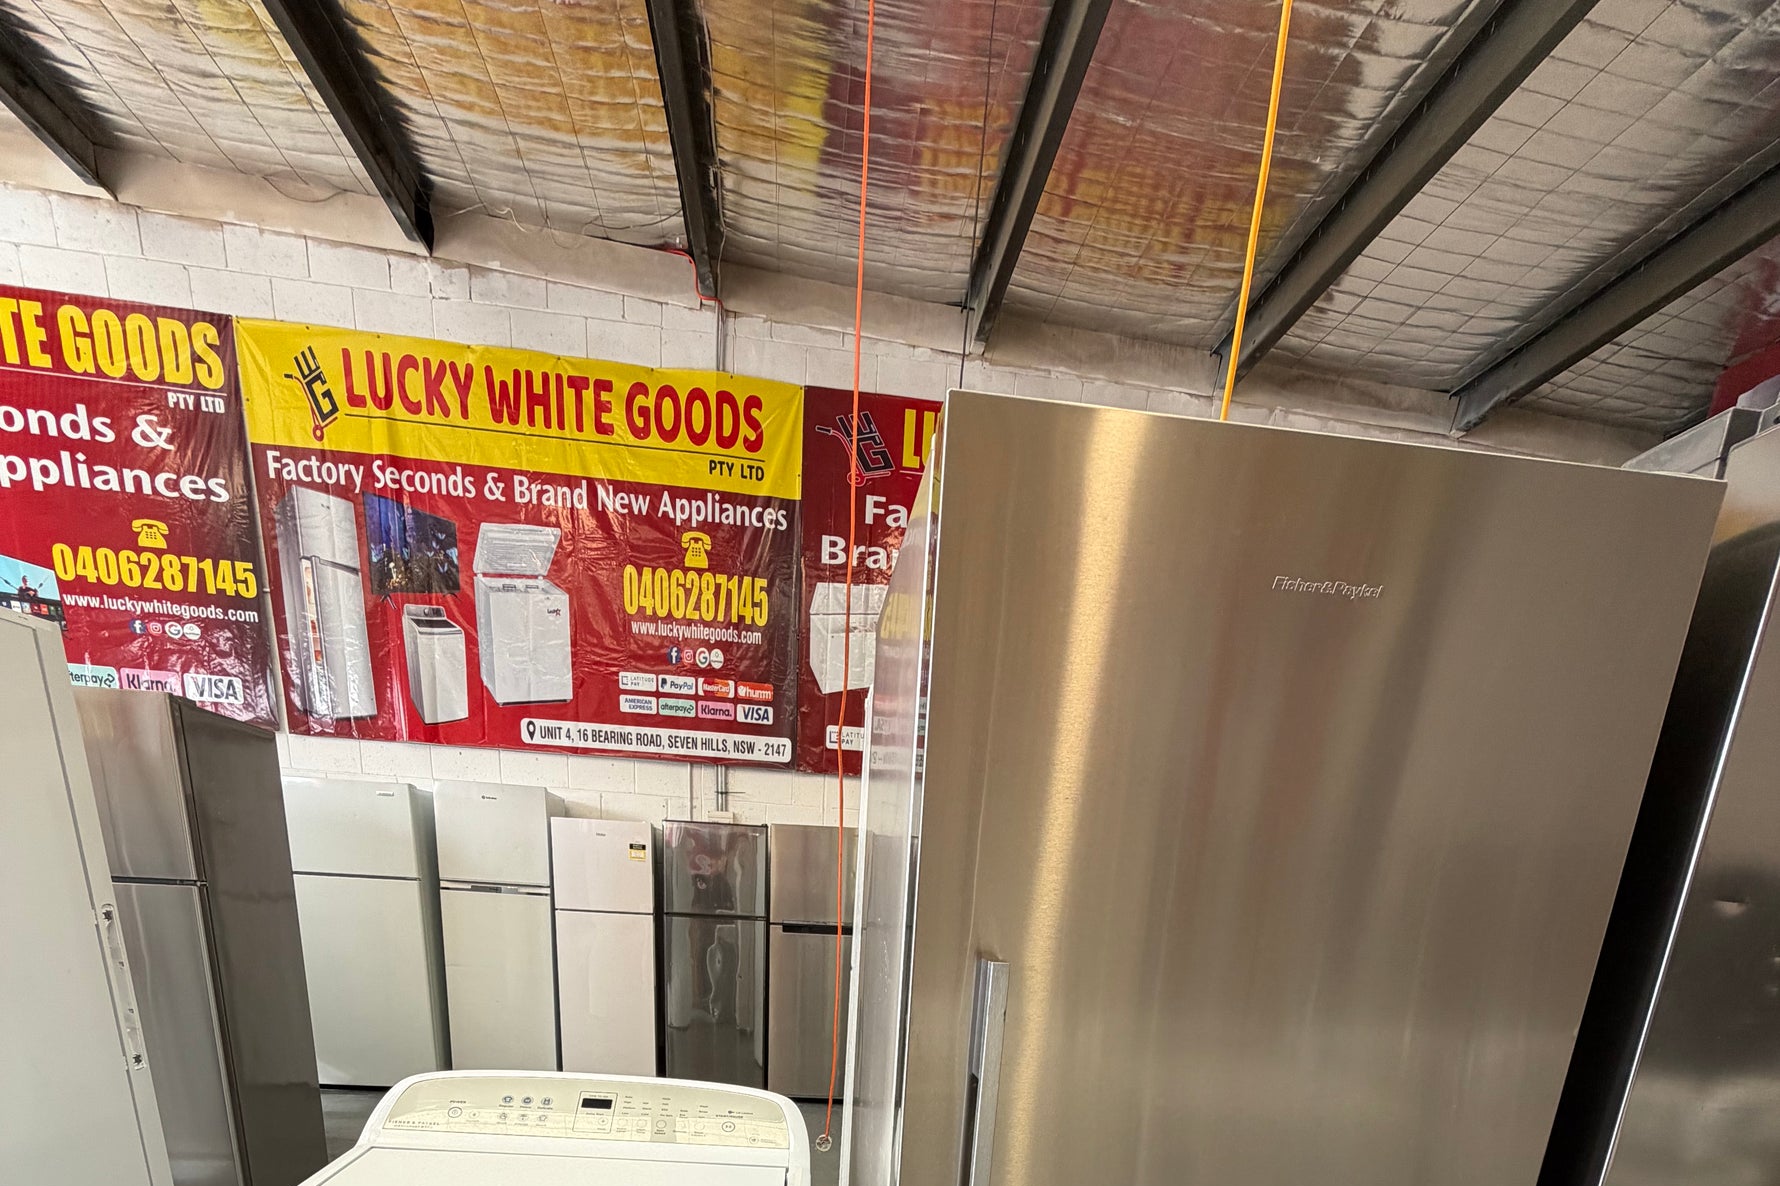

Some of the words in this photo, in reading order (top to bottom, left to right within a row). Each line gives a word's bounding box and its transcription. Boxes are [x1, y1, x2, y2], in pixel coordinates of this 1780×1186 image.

[57, 304, 225, 389] GOODS
[167, 391, 194, 411] PTY
[201, 395, 225, 414] LTD
[341, 347, 476, 420] LUCKY
[484, 364, 614, 437] WHITE
[624, 380, 765, 454] GOODS
[0, 403, 116, 443] onds
[131, 414, 175, 450] &
[0, 450, 230, 503] ppliances
[708, 459, 738, 478] PTY
[740, 462, 765, 483] LTD
[266, 449, 364, 494] Factory
[372, 459, 477, 499] Seconds
[483, 471, 506, 501] &
[514, 478, 588, 511] Brand
[597, 485, 651, 515] New
[657, 490, 788, 532] Appliances
[864, 494, 908, 529] Fa
[52, 543, 258, 599] 0406287145
[63, 593, 259, 623] www.luckywhitegoods.com
[623, 564, 769, 627] 0406287145
[631, 619, 762, 645] www.luckywhitegoods.com
[69, 670, 106, 688] terpay
[191, 675, 240, 700] VISA
[669, 681, 694, 692] PayPal
[624, 697, 653, 705] AMERICAN
[628, 704, 653, 712] EXPRESS
[660, 702, 687, 713] afterpay
[742, 706, 770, 722] VISA
[539, 725, 564, 741] UNIT
[565, 727, 575, 744] 4,
[576, 728, 589, 743] 16
[591, 729, 633, 746] BEARING
[636, 732, 665, 750] ROAD,
[667, 734, 698, 751] SEVEN
[700, 737, 731, 755] HILLS,
[733, 740, 756, 755] NSW
[764, 742, 787, 758] 2147
